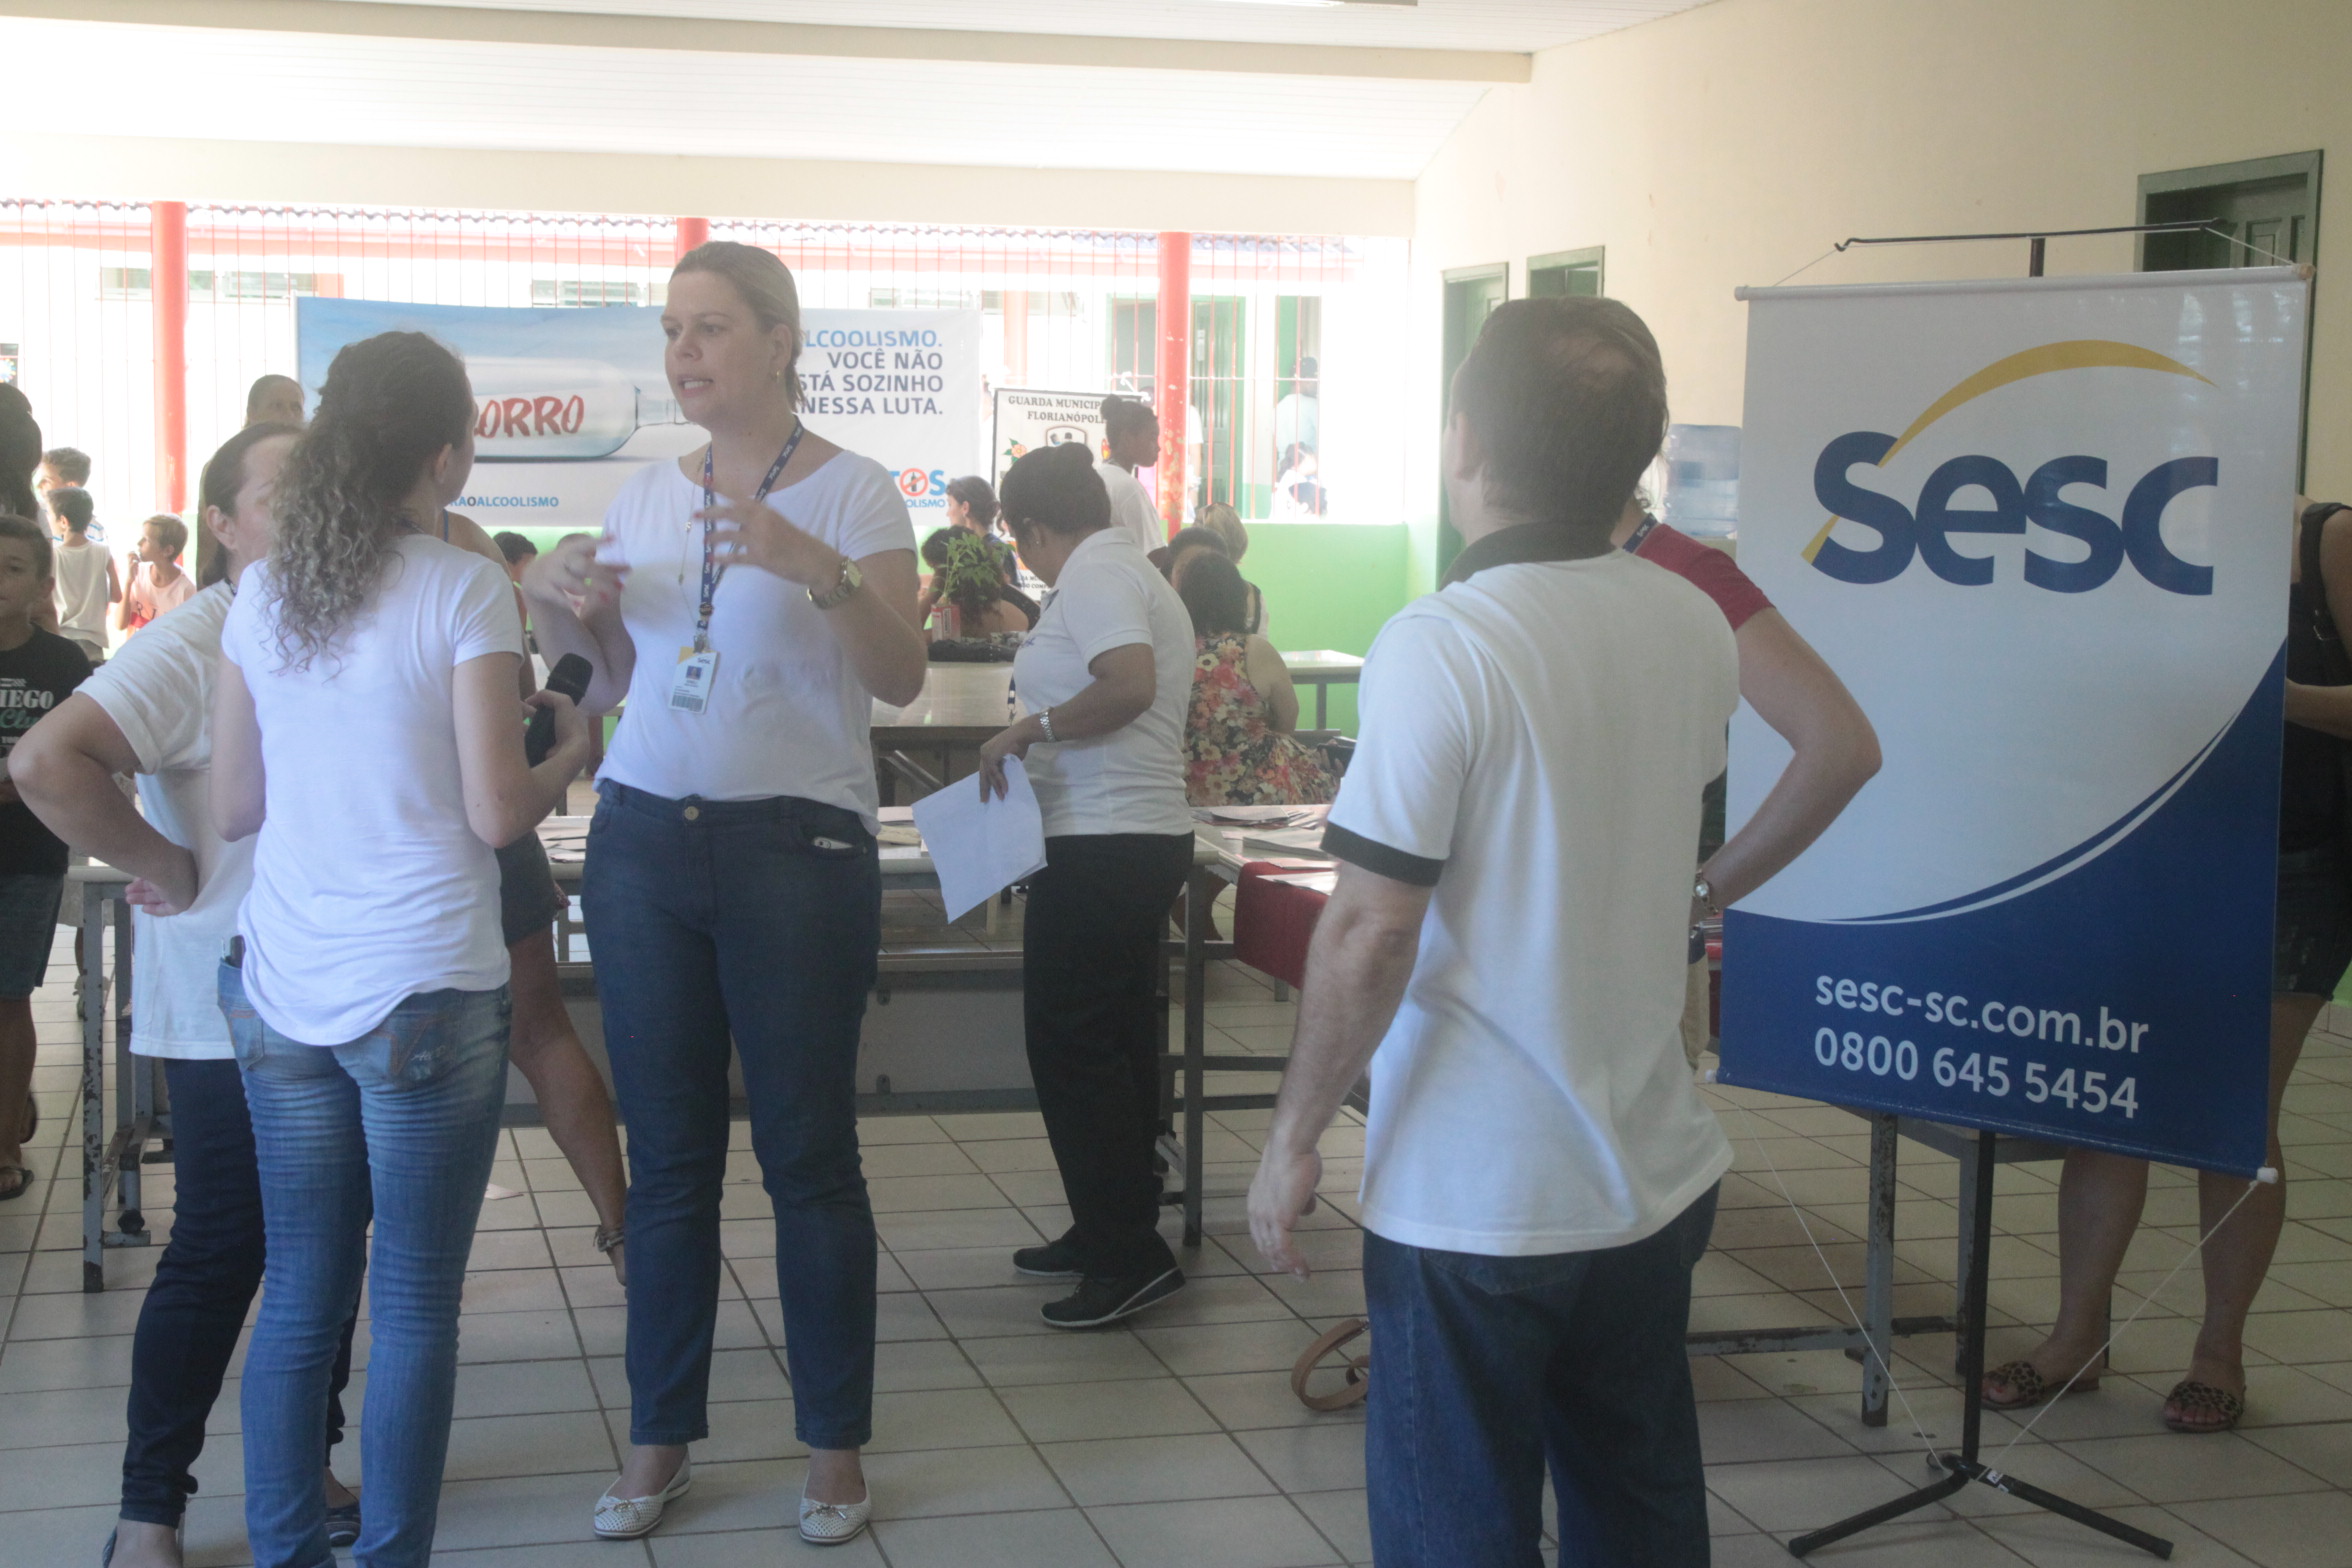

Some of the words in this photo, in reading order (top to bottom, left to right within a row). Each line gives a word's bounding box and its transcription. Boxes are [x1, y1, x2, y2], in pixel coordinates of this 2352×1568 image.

[805, 329, 943, 347] LCOOLISMO.
[827, 348, 885, 369] VOCÊ
[894, 349, 943, 370] NÃO
[799, 370, 835, 392] STÁ
[843, 374, 943, 392] SOZINHO
[801, 397, 876, 415] NESSA
[883, 397, 943, 415] LUTA.
[1008, 396, 1053, 407] GUARDA
[1056, 398, 1101, 410] MUNICIP
[474, 395, 585, 438] ORRO
[1027, 410, 1106, 424] FLORIANÓPOLI
[905, 499, 946, 508] OLISMO
[1815, 975, 2149, 1053] sesc-sc.com.br
[1814, 1027, 1919, 1081] 0800
[1932, 1047, 2010, 1097] 645
[2025, 1062, 2139, 1119] 5454
